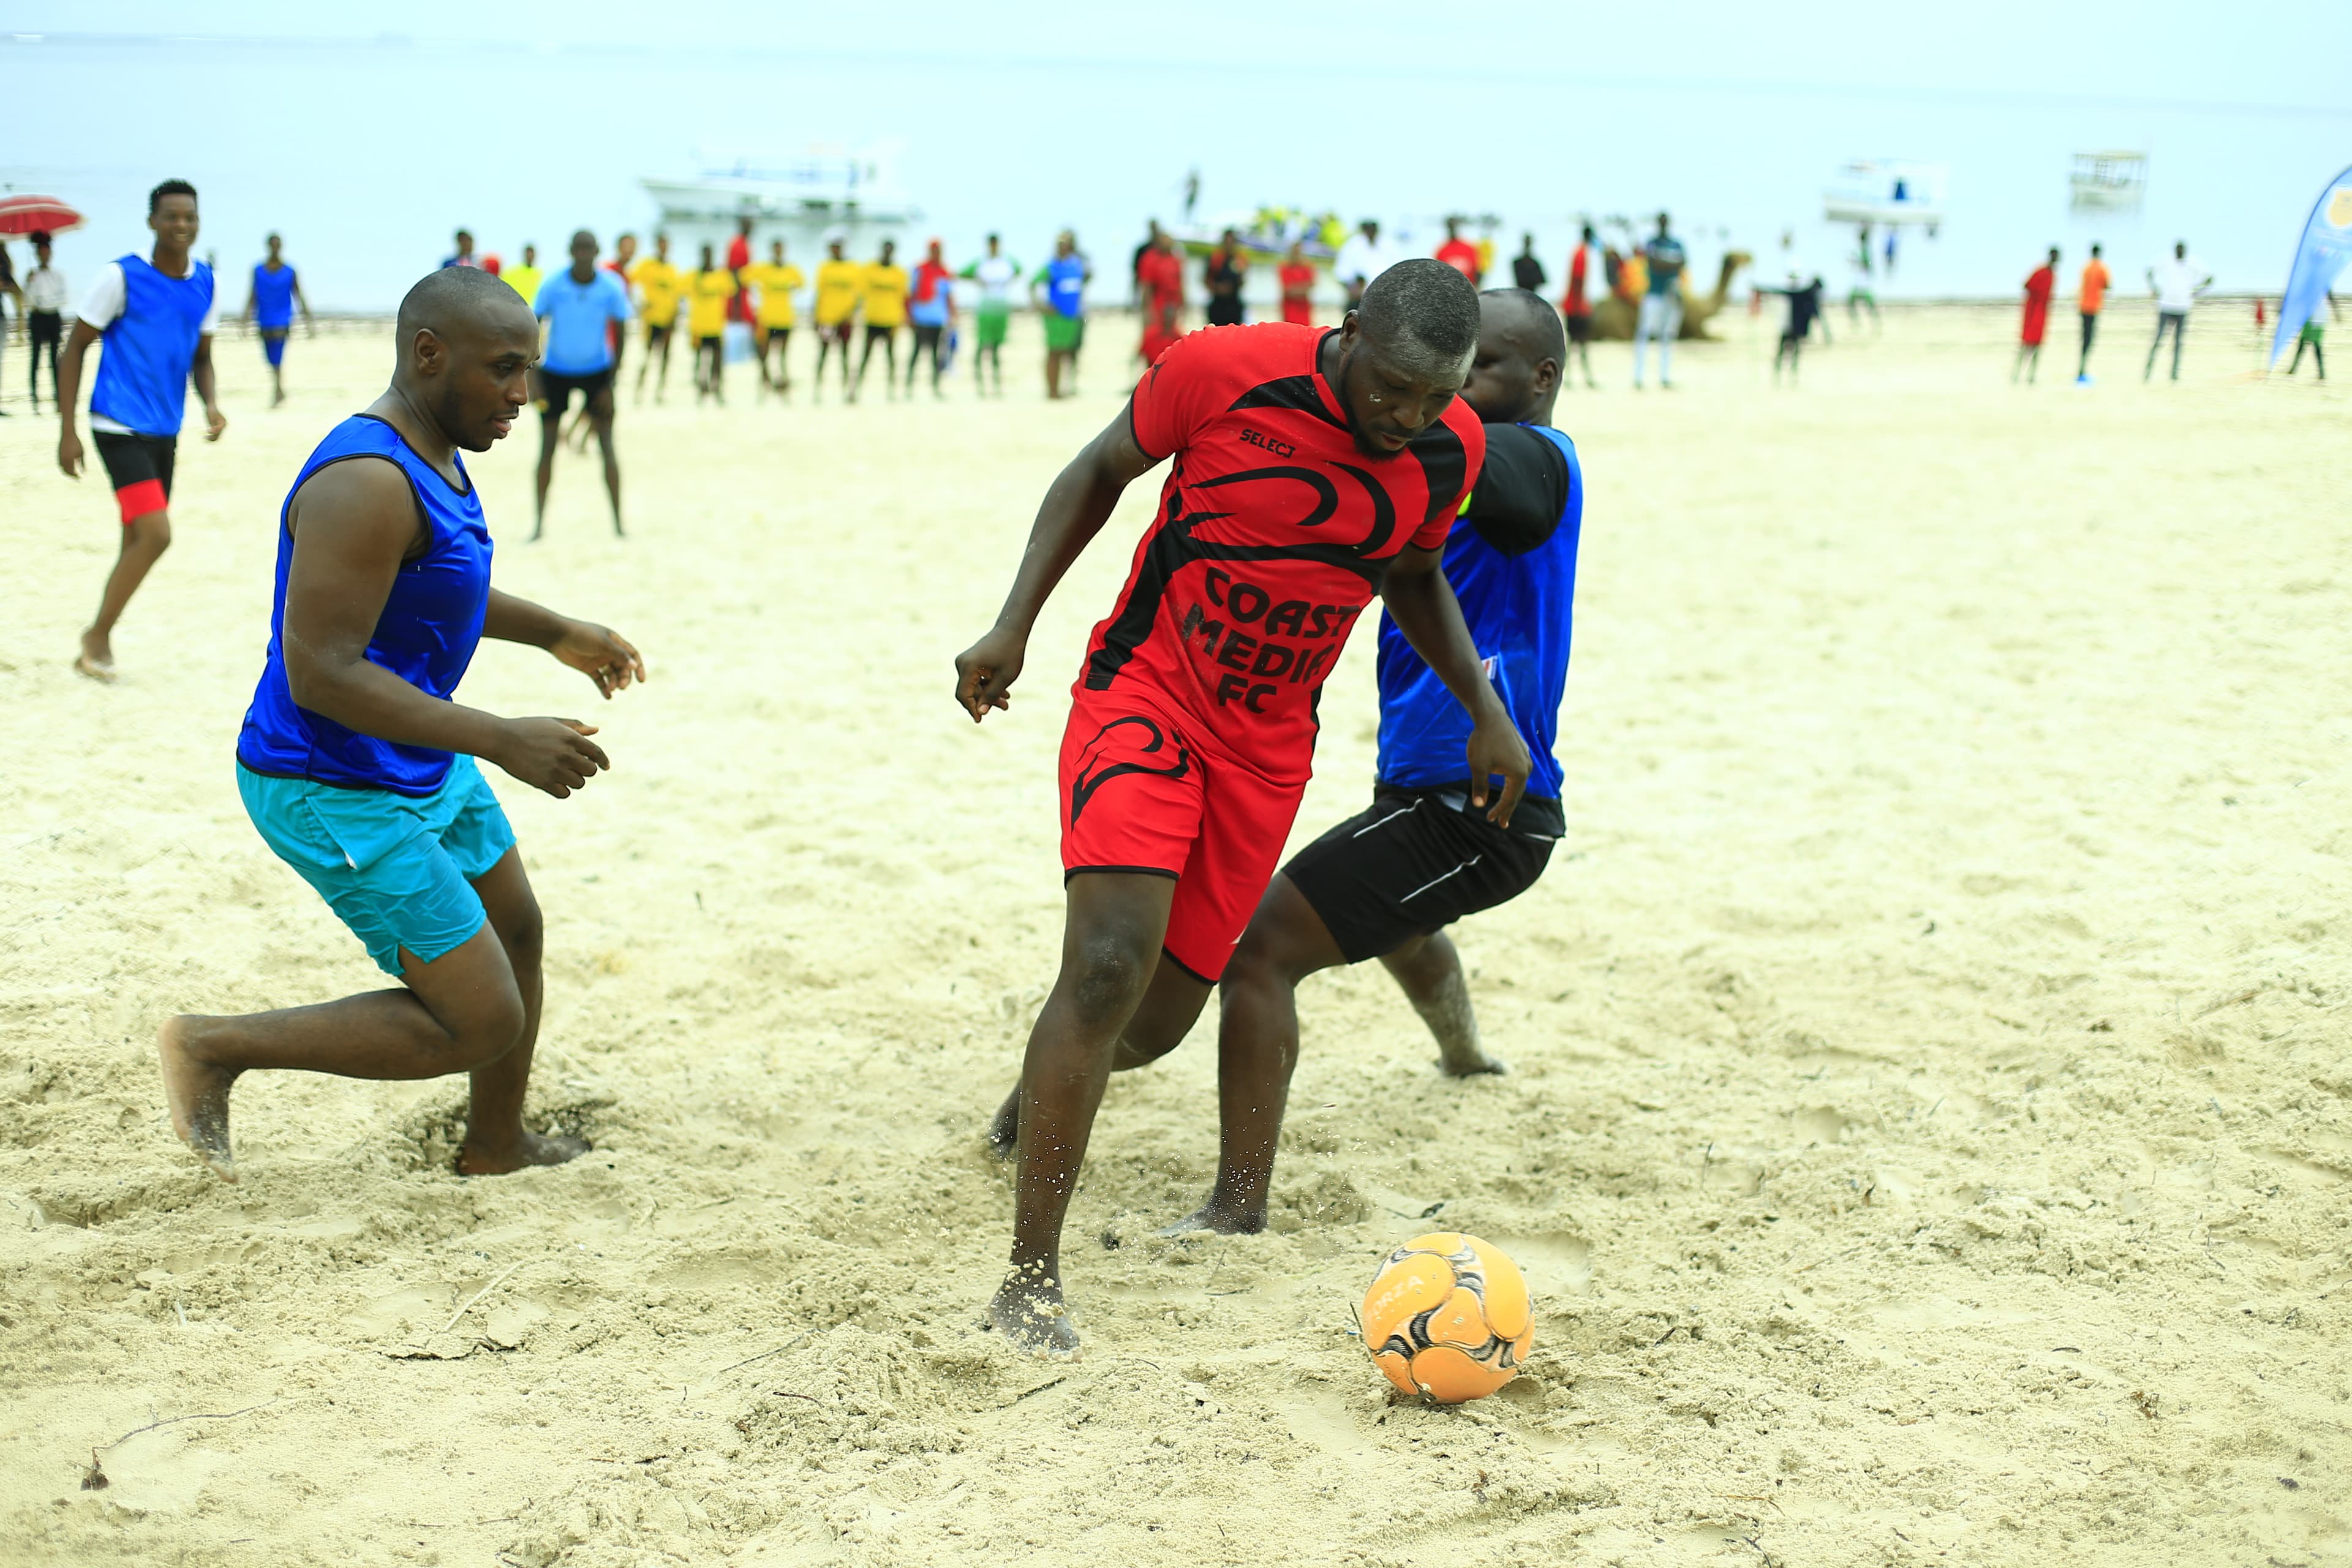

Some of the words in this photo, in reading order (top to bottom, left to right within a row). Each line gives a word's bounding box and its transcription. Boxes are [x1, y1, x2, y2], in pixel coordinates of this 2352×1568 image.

[1239, 429, 1296, 458] SELECT
[1205, 567, 1360, 639] COAST
[1183, 603, 1335, 685] MEDIA
[1216, 673, 1277, 714] FC
